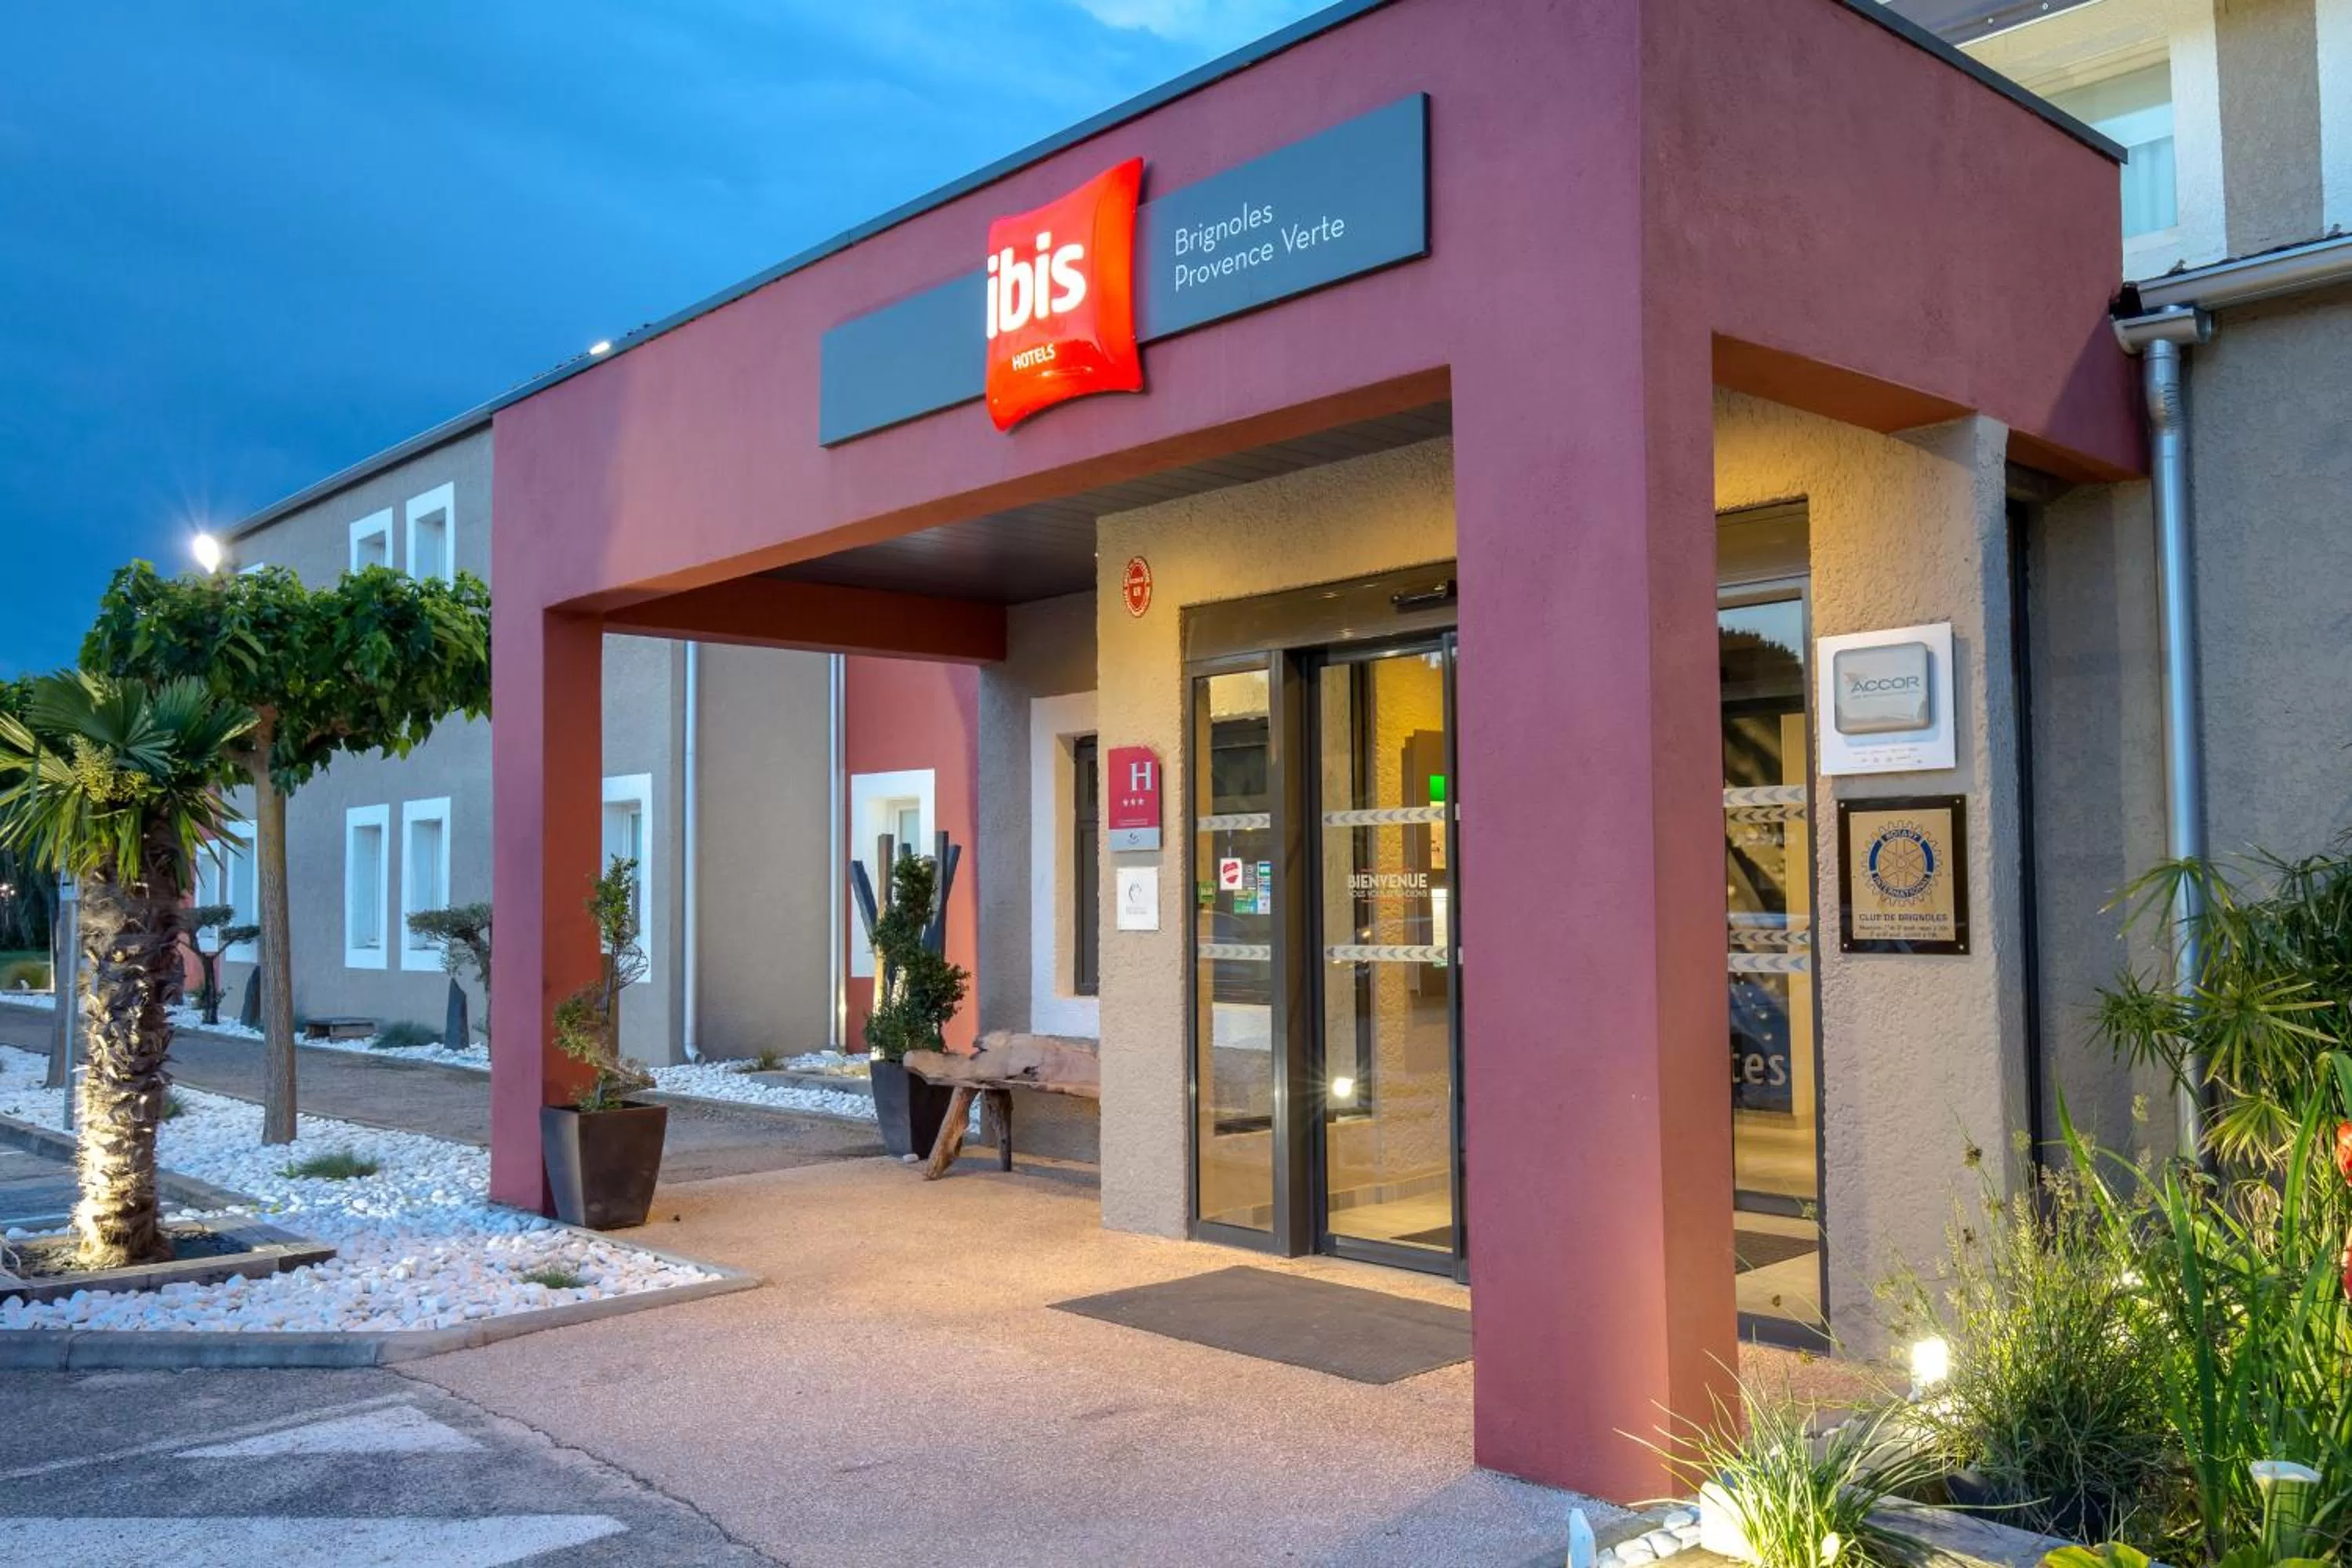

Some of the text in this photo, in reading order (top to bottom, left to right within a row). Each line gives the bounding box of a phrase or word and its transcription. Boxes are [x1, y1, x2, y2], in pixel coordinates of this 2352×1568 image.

[1175, 201, 1273, 256] Brignoles
[1175, 216, 1345, 292] Provence Verte
[986, 231, 1087, 339] ibis
[1012, 343, 1055, 372] HOTELS
[1851, 676, 1920, 693] ACCOR
[1130, 761, 1153, 792] H
[1348, 873, 1428, 888] BIENVENUE
